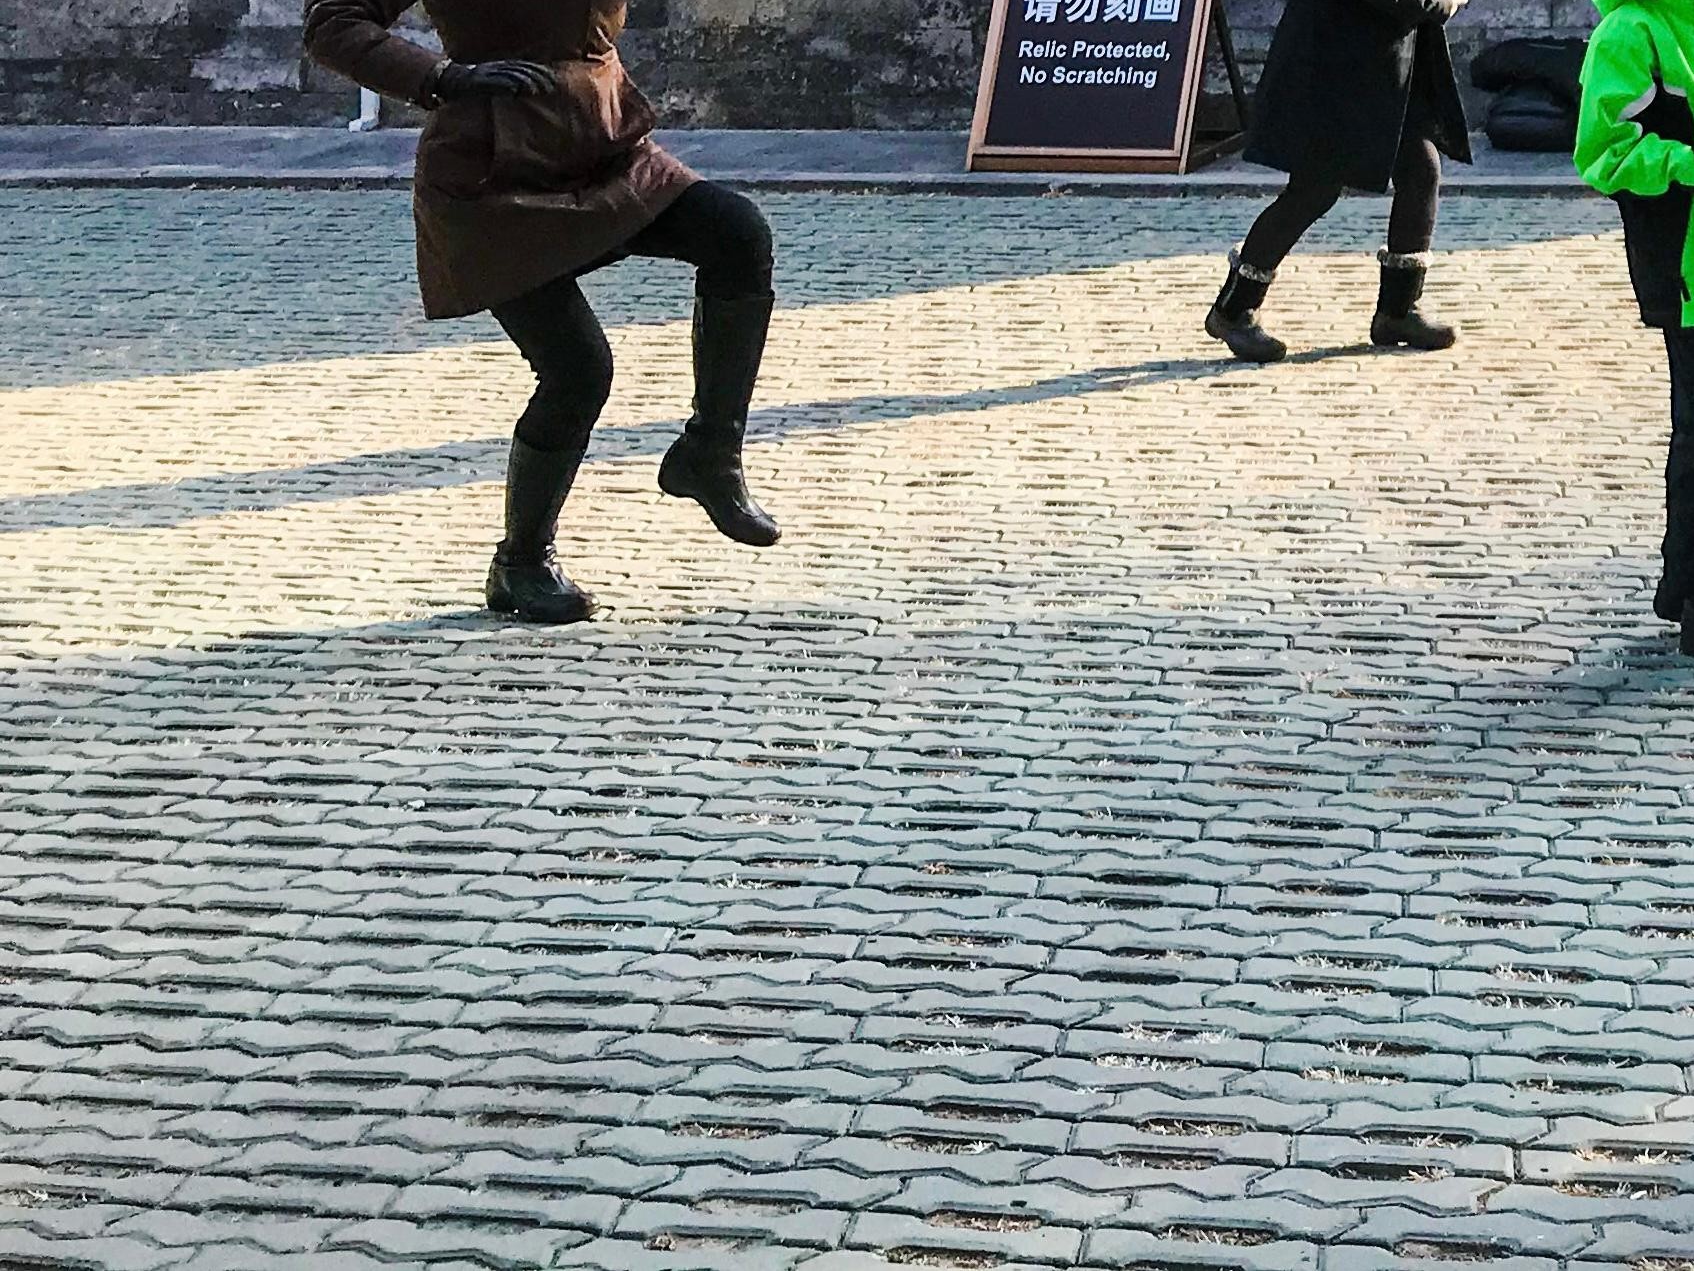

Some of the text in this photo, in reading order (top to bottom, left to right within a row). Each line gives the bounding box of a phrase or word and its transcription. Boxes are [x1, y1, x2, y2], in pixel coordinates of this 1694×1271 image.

[1018, 40, 1171, 62] Relic Protected,
[1019, 66, 1158, 89] No Scratching
